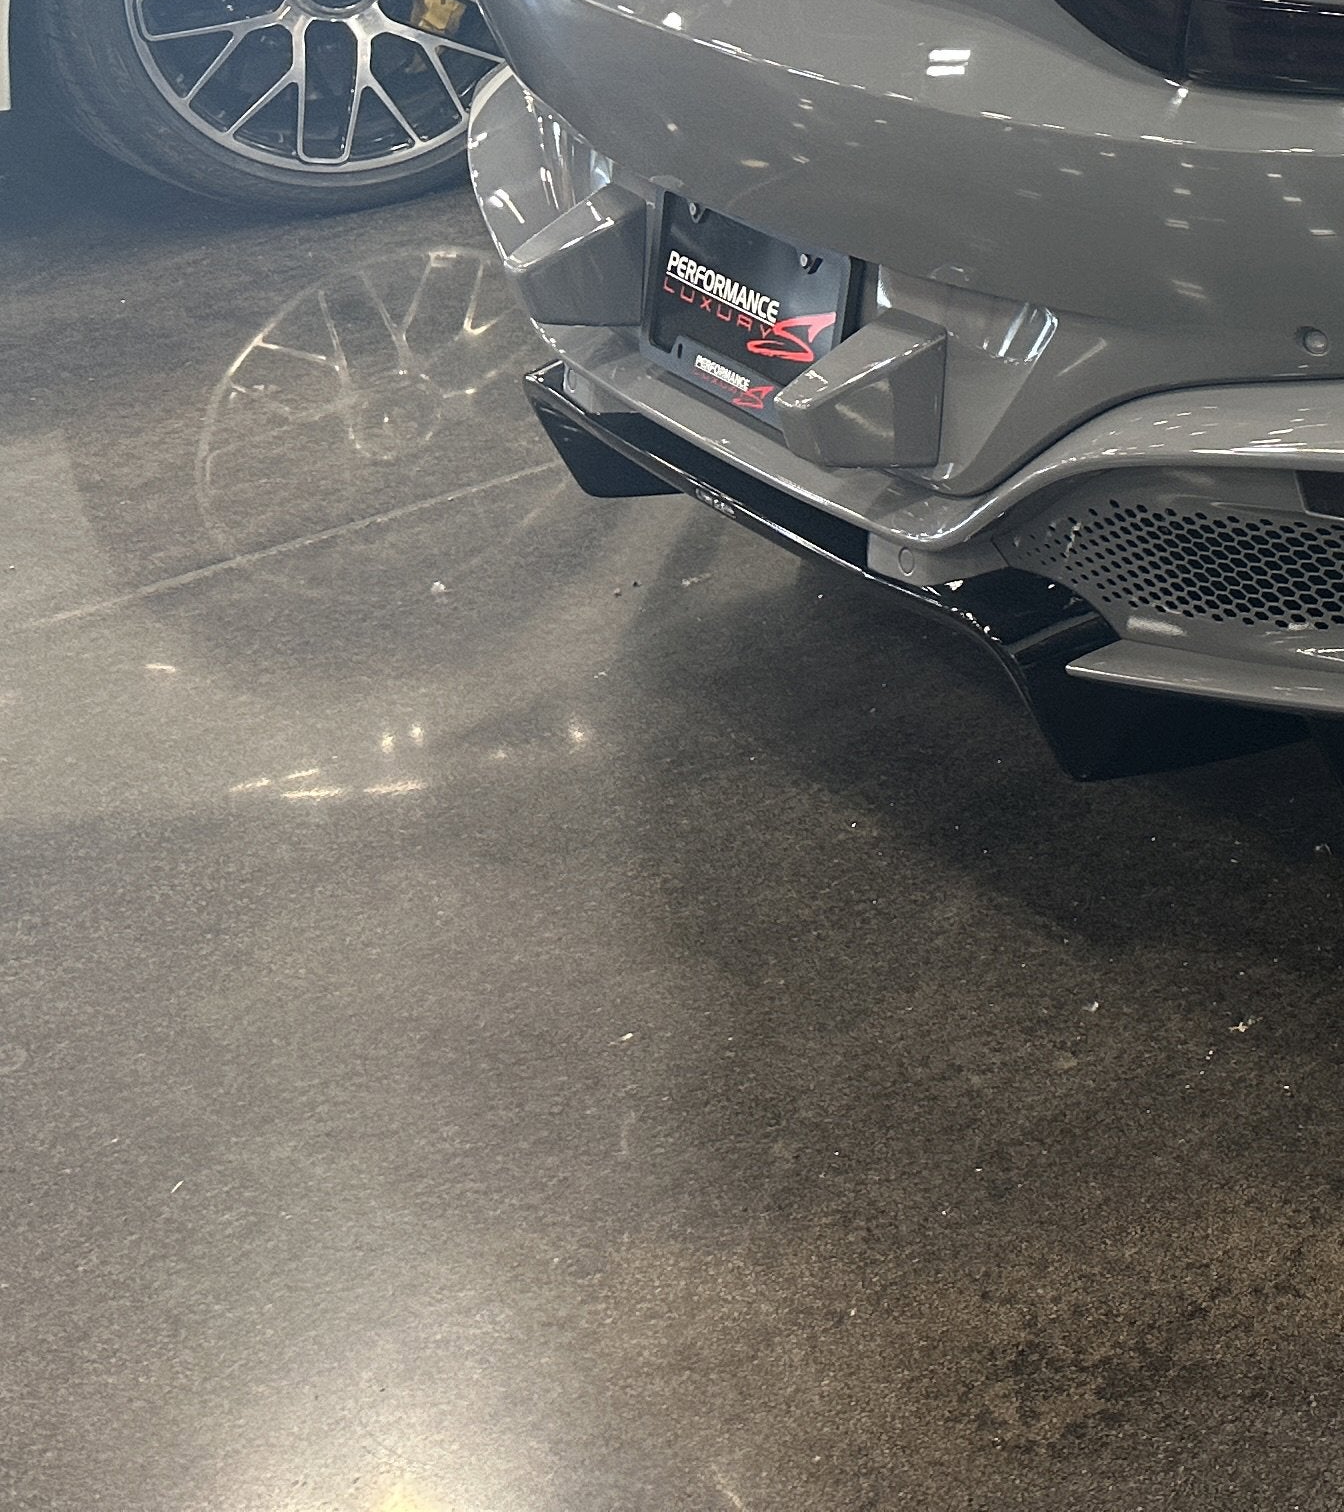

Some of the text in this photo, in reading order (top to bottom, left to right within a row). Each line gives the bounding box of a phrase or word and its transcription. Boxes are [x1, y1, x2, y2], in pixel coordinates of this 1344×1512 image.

[663, 277, 773, 339] LUXURY
[666, 250, 781, 324] PERFORMANCE
[695, 354, 751, 392] PERFORMANCE
